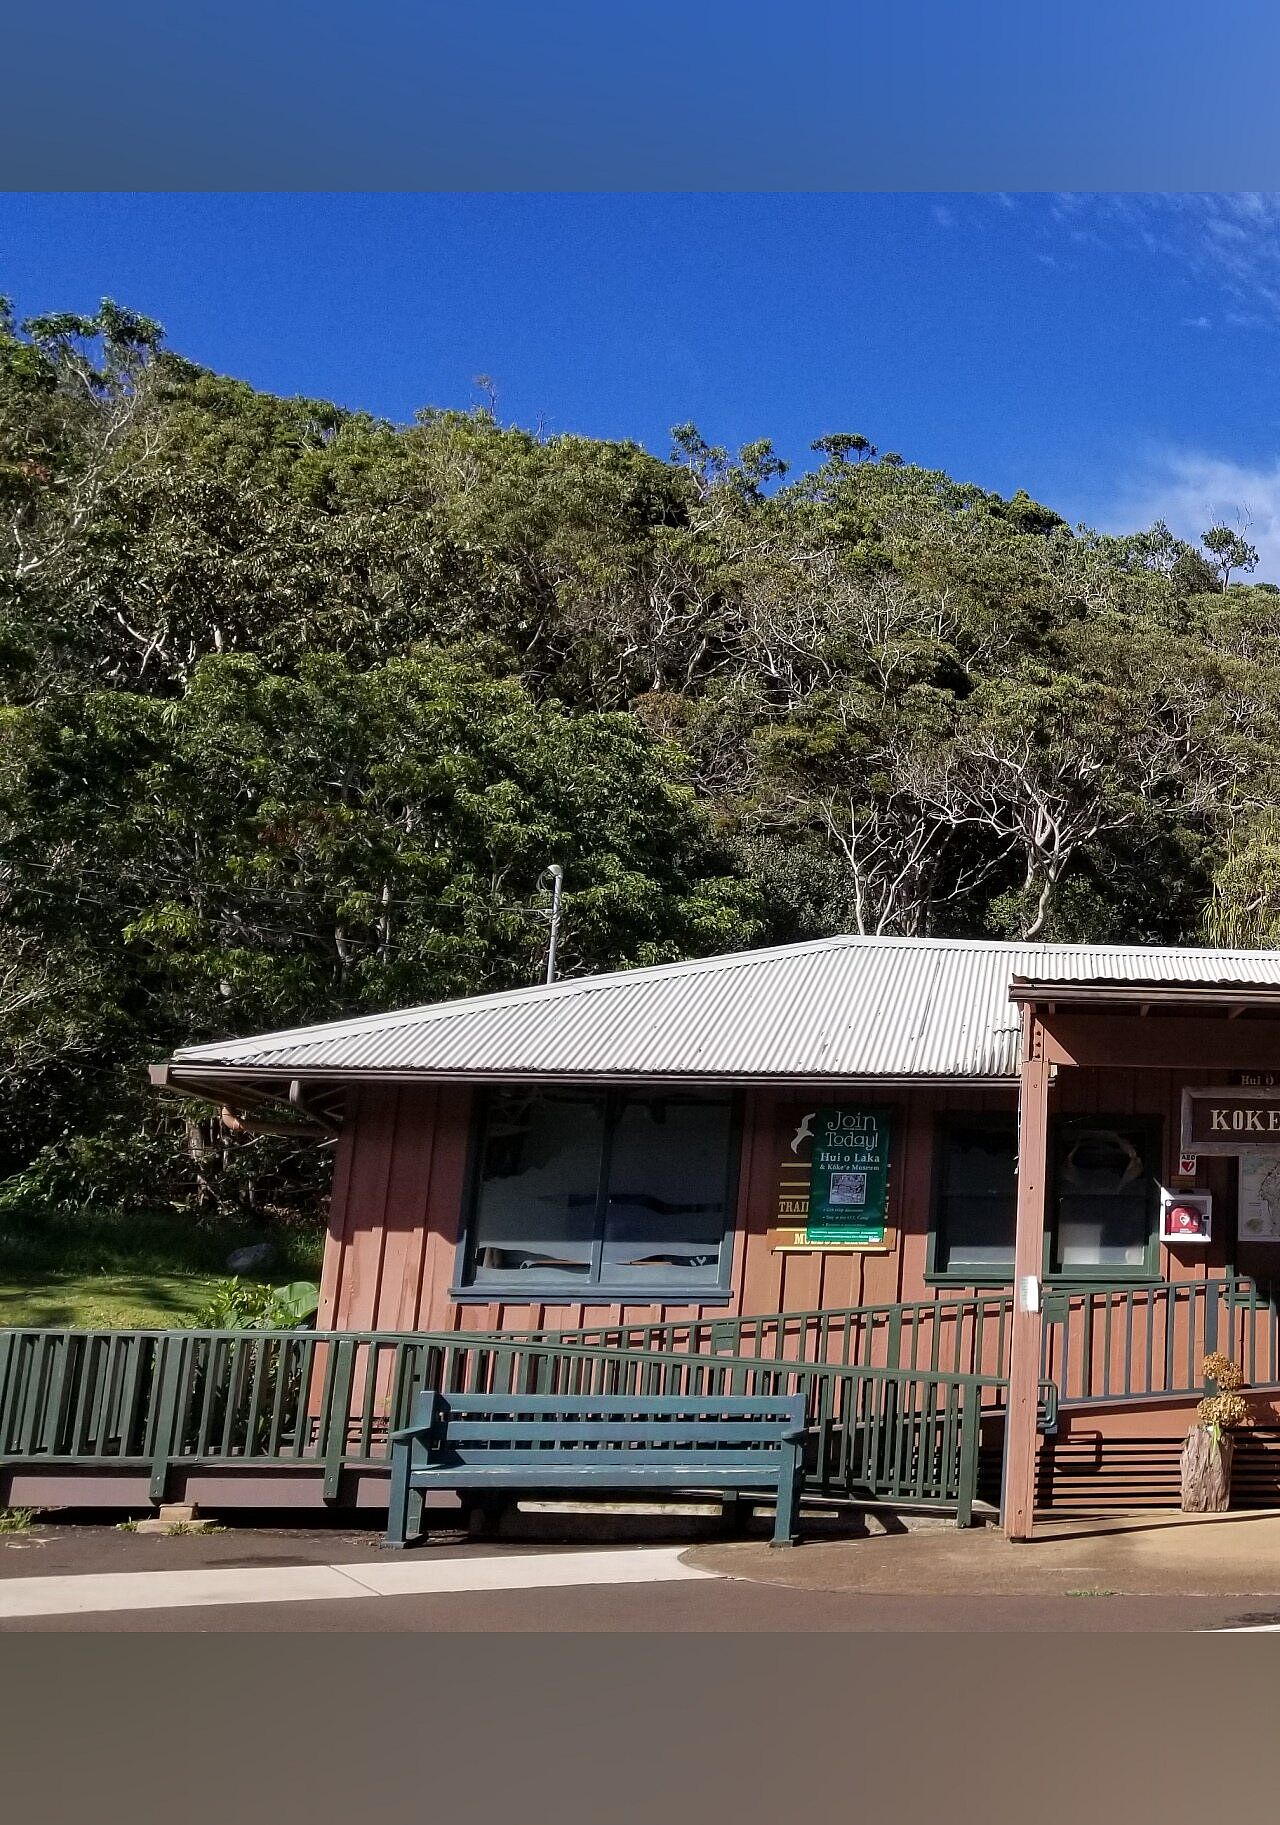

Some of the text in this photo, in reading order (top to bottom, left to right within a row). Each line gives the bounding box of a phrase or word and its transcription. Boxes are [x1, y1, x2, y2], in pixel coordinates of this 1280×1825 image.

[1241, 1074, 1261, 1086] Hui
[827, 1110, 879, 1131] Join
[825, 1131, 879, 1151] Today!
[820, 1152, 841, 1162] Hui
[854, 1152, 880, 1163] Laka
